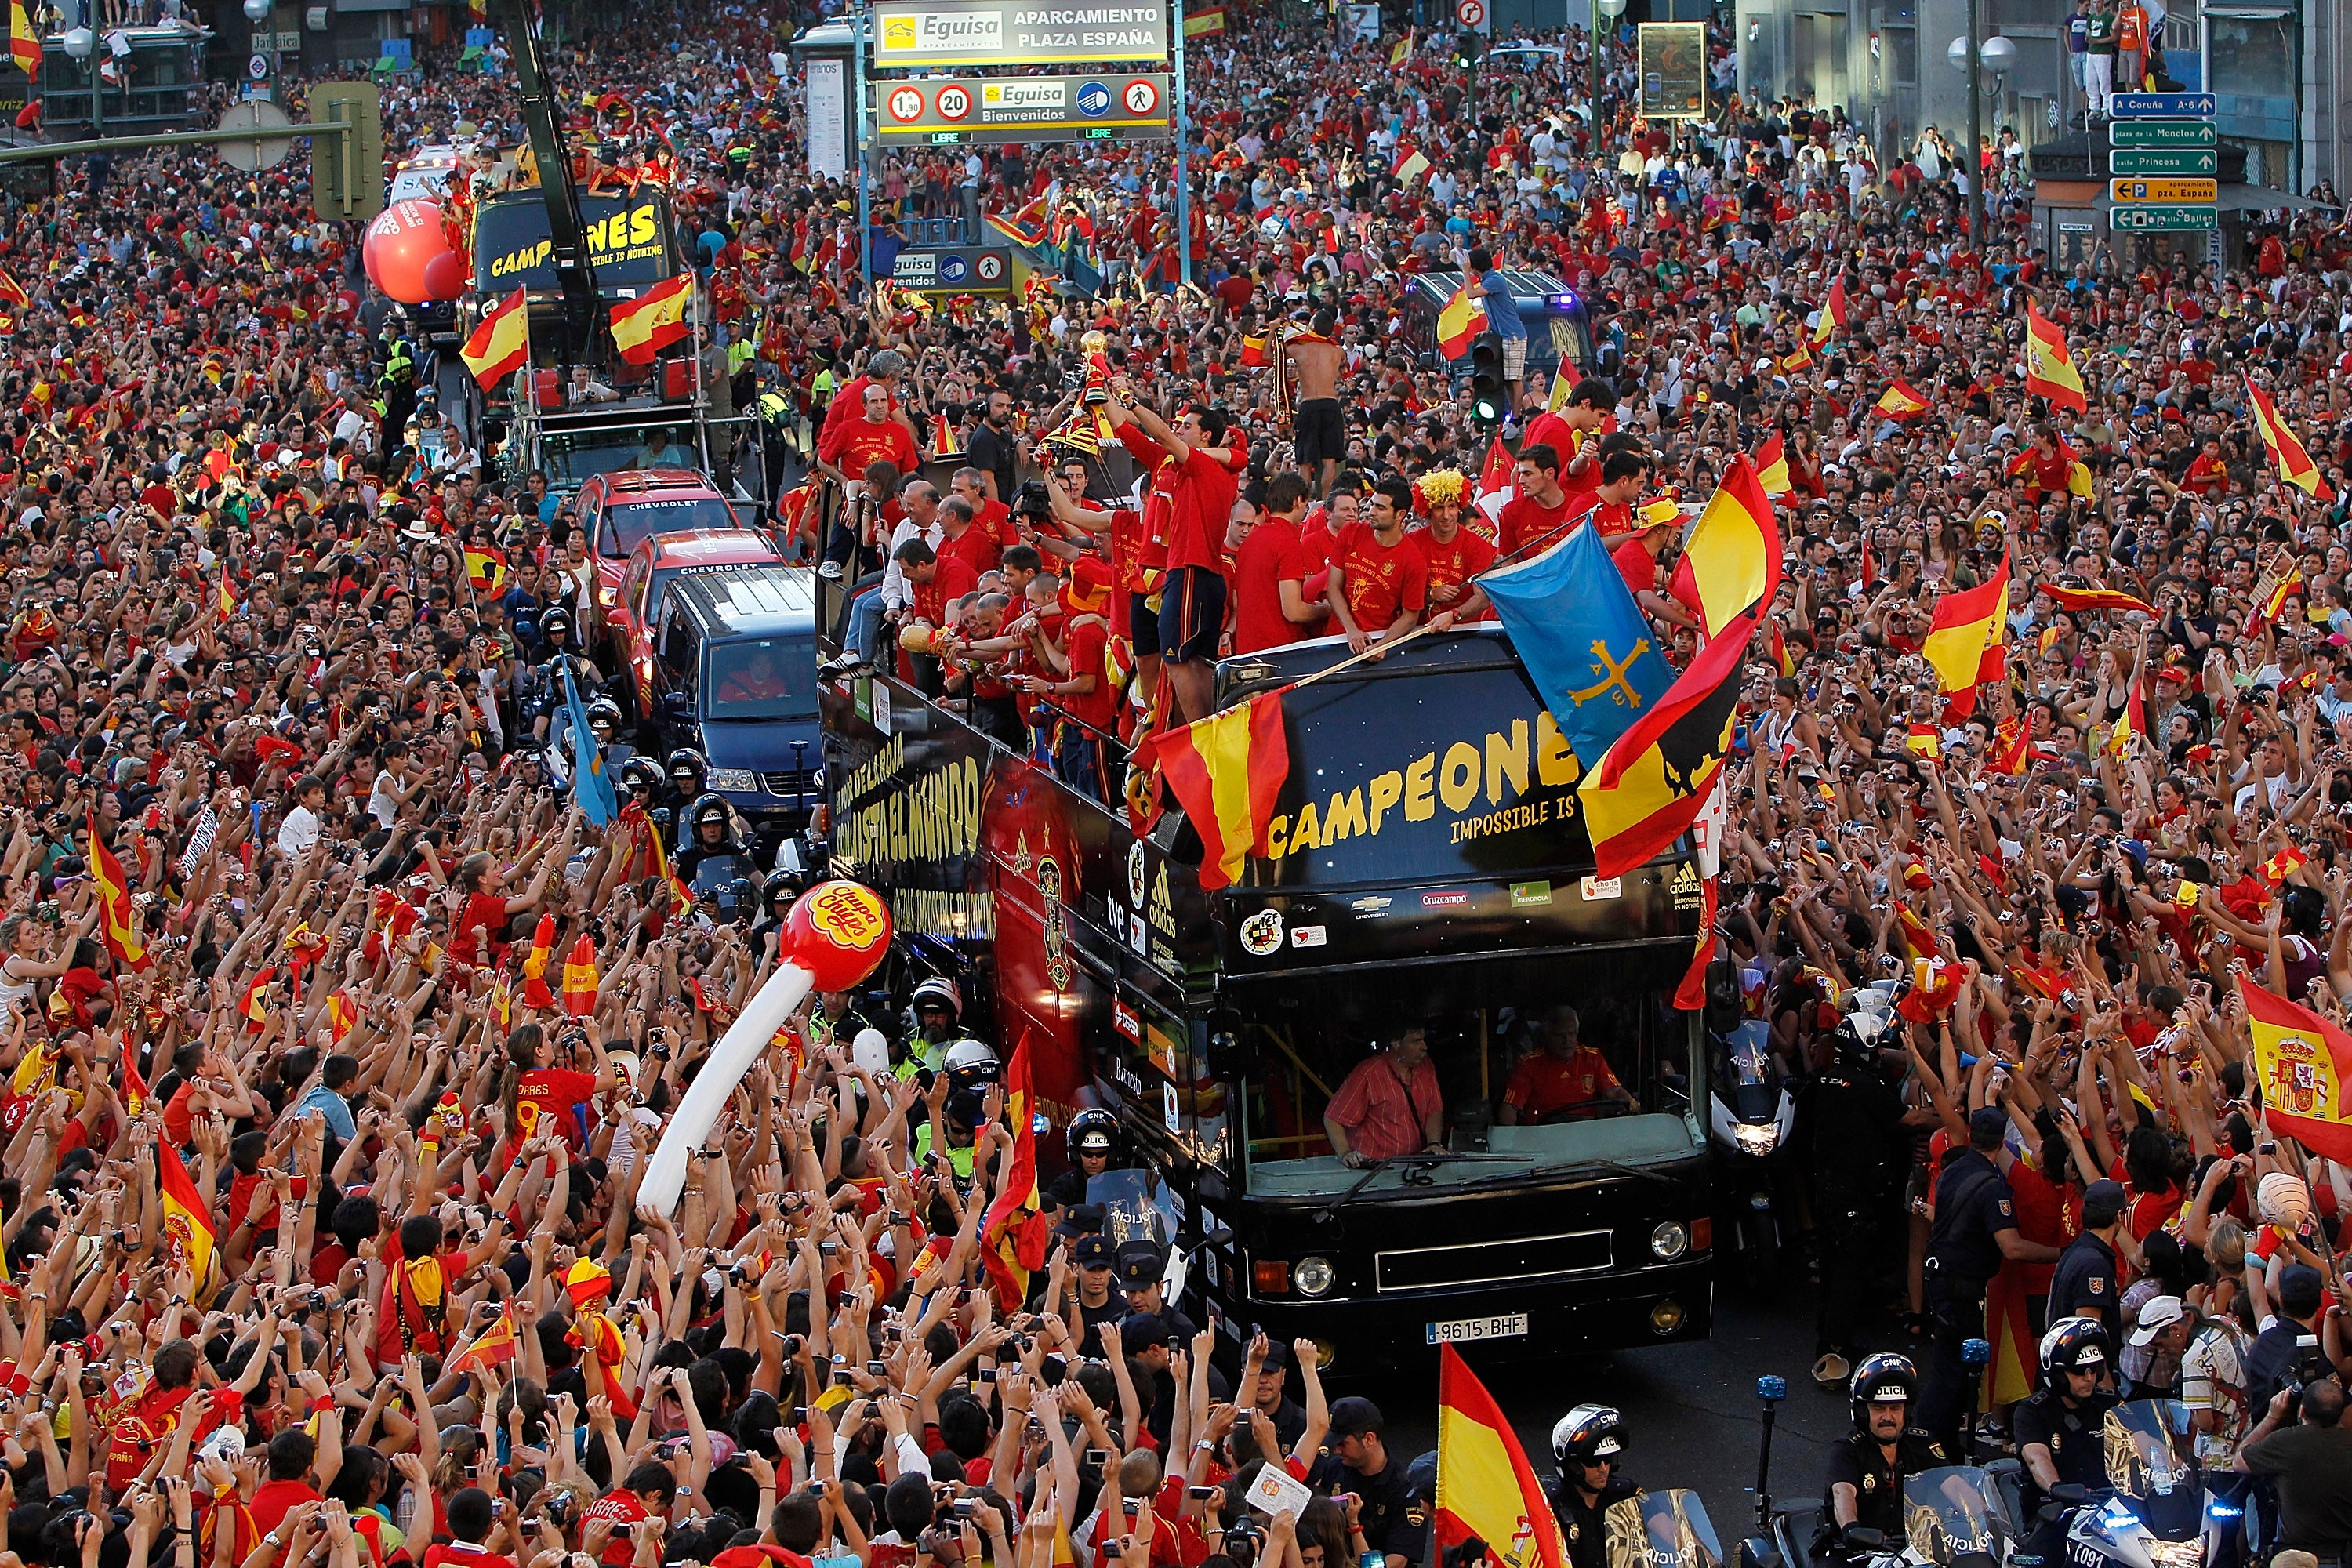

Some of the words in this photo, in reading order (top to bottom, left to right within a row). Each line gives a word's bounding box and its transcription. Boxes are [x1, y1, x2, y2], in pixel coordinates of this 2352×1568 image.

[1014, 9, 1157, 25] APARCAMIENTO
[924, 15, 999, 40] Eguisa
[1018, 33, 1078, 48] PLAZA
[1083, 28, 1156, 46] ESPAÑA
[1003, 85, 1062, 104] Eguisa
[944, 95, 963, 111] 20
[2129, 100, 2163, 109] Coruña
[982, 108, 1065, 122] Bienvenidos
[931, 132, 959, 143] LIBRE
[1085, 129, 1112, 139] LIBRE
[2157, 129, 2194, 137] Moncloa
[2139, 157, 2180, 166] Princesa
[403, 176, 446, 191] SAM
[2180, 188, 2213, 198] España
[491, 204, 657, 278] CAMPNES
[590, 252, 613, 267] SIBLE
[615, 251, 625, 262] IS
[626, 244, 663, 261] NOTHING
[894, 257, 932, 273] guisa
[893, 276, 935, 286] venidos
[851, 443, 875, 454] CAMPEONES
[628, 499, 699, 511] CHEVROLET
[680, 564, 757, 575] CHEVROLET
[1345, 562, 1367, 573] MPEONES
[1375, 575, 1390, 591] MUNDO
[836, 790, 841, 815] EL
[854, 761, 867, 798] DE
[867, 753, 880, 791] LA
[880, 731, 904, 782] ROJA
[1268, 711, 1579, 860] CAMPEONE
[890, 790, 907, 862] EL
[909, 755, 978, 863] MUNDO
[1451, 803, 1548, 844] IMPOSSIBLE
[1556, 795, 1574, 818] IS
[1669, 880, 1700, 894] adidas
[833, 887, 877, 925] Chupa
[1422, 894, 1467, 906] Cruzcampo
[1517, 895, 1549, 904] IBERDROLA
[818, 895, 868, 938] Chups
[1108, 889, 1125, 941] tve
[1149, 902, 1176, 939] adidas
[1122, 1012, 1138, 1037] CEPSA
[1149, 1040, 1167, 1060] expert
[1116, 1056, 1142, 1098] Banesto
[517, 1100, 539, 1140] 9
[1441, 1320, 1483, 1339] 9615
[1490, 1317, 1523, 1335] BHF
[2080, 1322, 2098, 1331] CNP
[1882, 1359, 1902, 1367] CNP
[1600, 1413, 1618, 1424] CNP
[1597, 1436, 1619, 1450] LICI
[585, 1498, 633, 1519] ORRES
